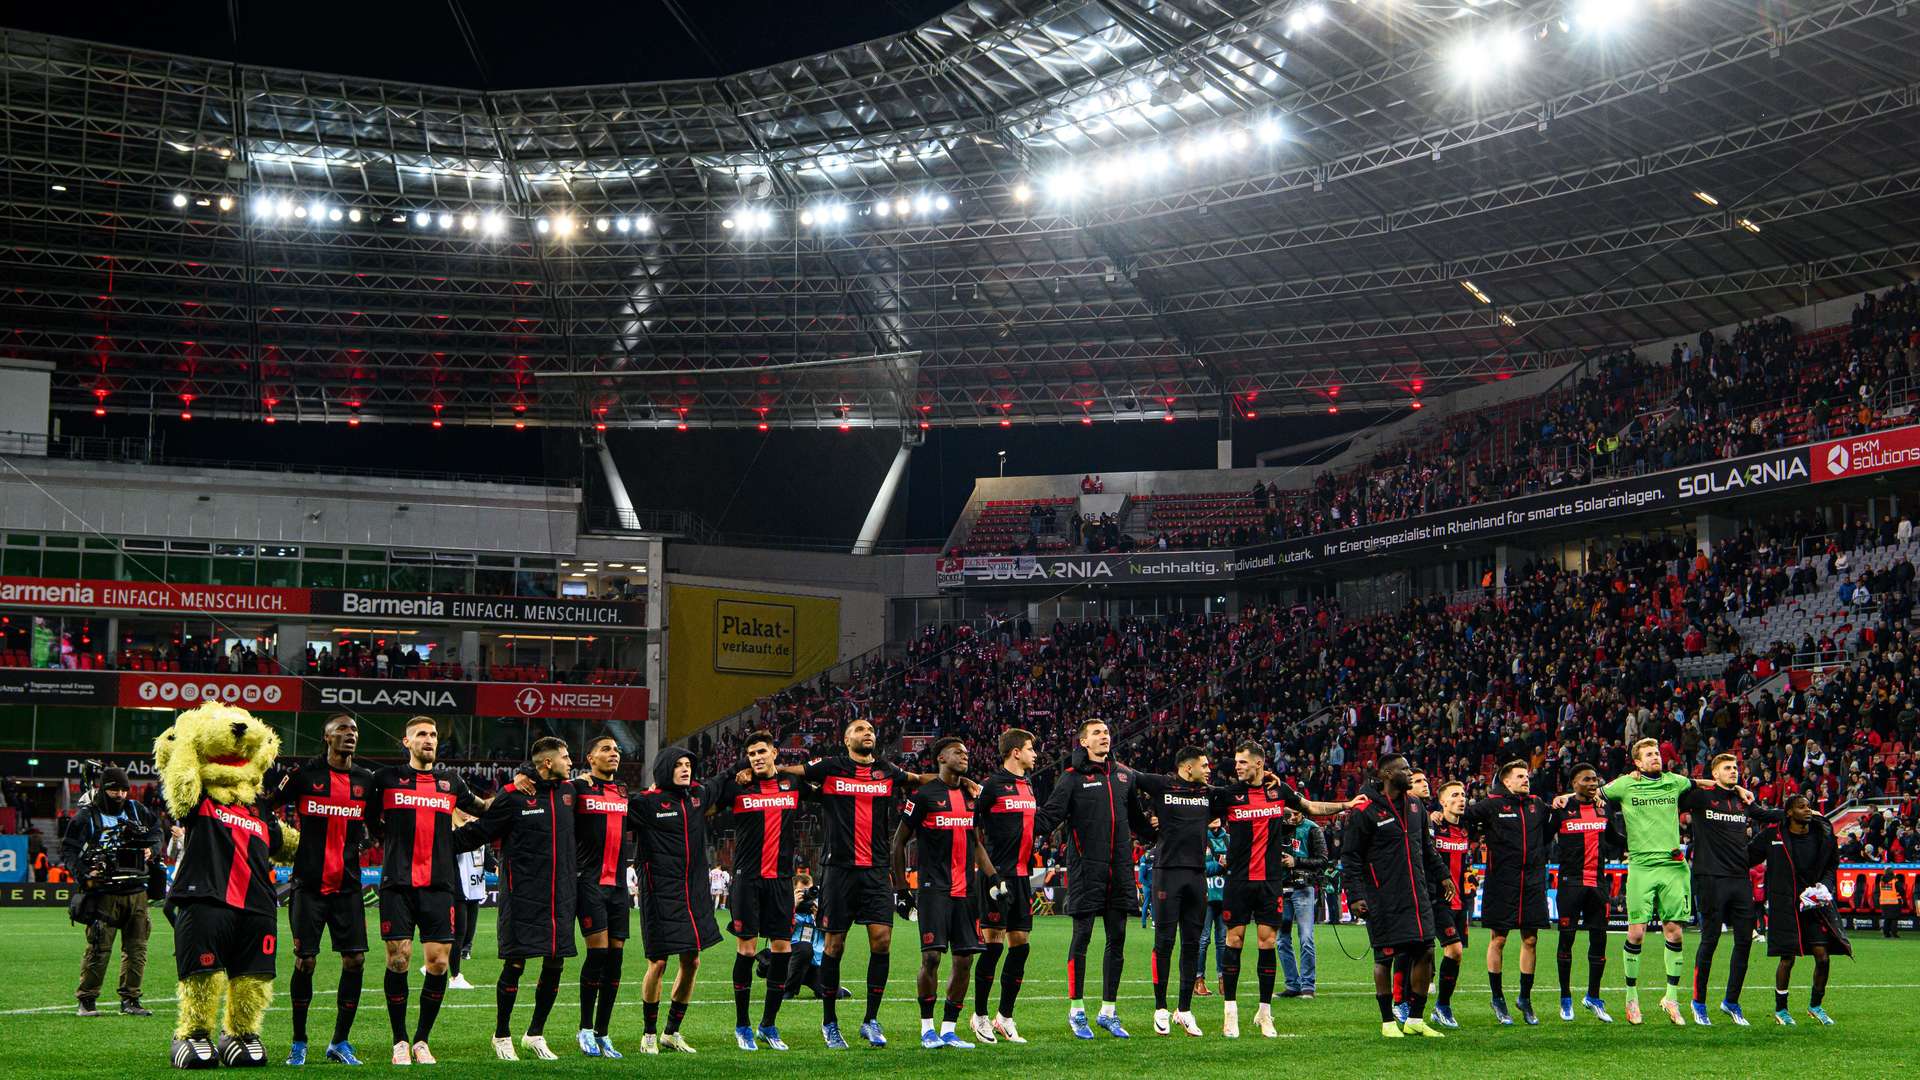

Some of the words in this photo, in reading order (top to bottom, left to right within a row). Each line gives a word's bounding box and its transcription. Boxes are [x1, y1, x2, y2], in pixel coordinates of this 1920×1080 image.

[1852, 439, 1880, 455] PKM
[1852, 447, 1920, 470] solutions
[1678, 456, 1808, 499] SOLARNIA
[1130, 559, 1220, 576] Nachhaltig.
[1278, 547, 1314, 565] Autark.
[1324, 543, 1338, 557] Ihr
[1340, 526, 1431, 554] Energiespezialist
[1433, 525, 1446, 537] im
[1448, 514, 1505, 535] Rheinland
[1507, 511, 1527, 525] für
[1528, 503, 1572, 521] smarte
[1575, 487, 1665, 514] Solaranlagen.
[104, 588, 175, 607] EINFACH.
[181, 591, 288, 610] MENSCHLICH.
[343, 593, 444, 615] Barmenia
[452, 601, 519, 620] EINFACH.
[525, 605, 623, 623] MENSCHLICH.
[722, 615, 790, 638] Plakat-
[722, 640, 790, 656] verkauft.de
[320, 688, 457, 708] SOLARNIA
[550, 693, 614, 708] NRG24
[836, 780, 888, 794] Barmenia
[395, 792, 450, 810] Barmenia
[586, 798, 628, 812] Barmen
[742, 795, 795, 809] Barmenia
[1005, 799, 1036, 810] Barme
[1164, 794, 1209, 807] Barmenia
[1631, 796, 1676, 807] Barmenia
[307, 801, 362, 818] Barmenia
[522, 808, 545, 816] Barmenia
[1235, 804, 1282, 819] Barmenia
[935, 815, 974, 827] Barmeni
[1566, 820, 1607, 831] Barmeni
[1435, 839, 1468, 851] Barmen
[262, 934, 275, 955] 0
